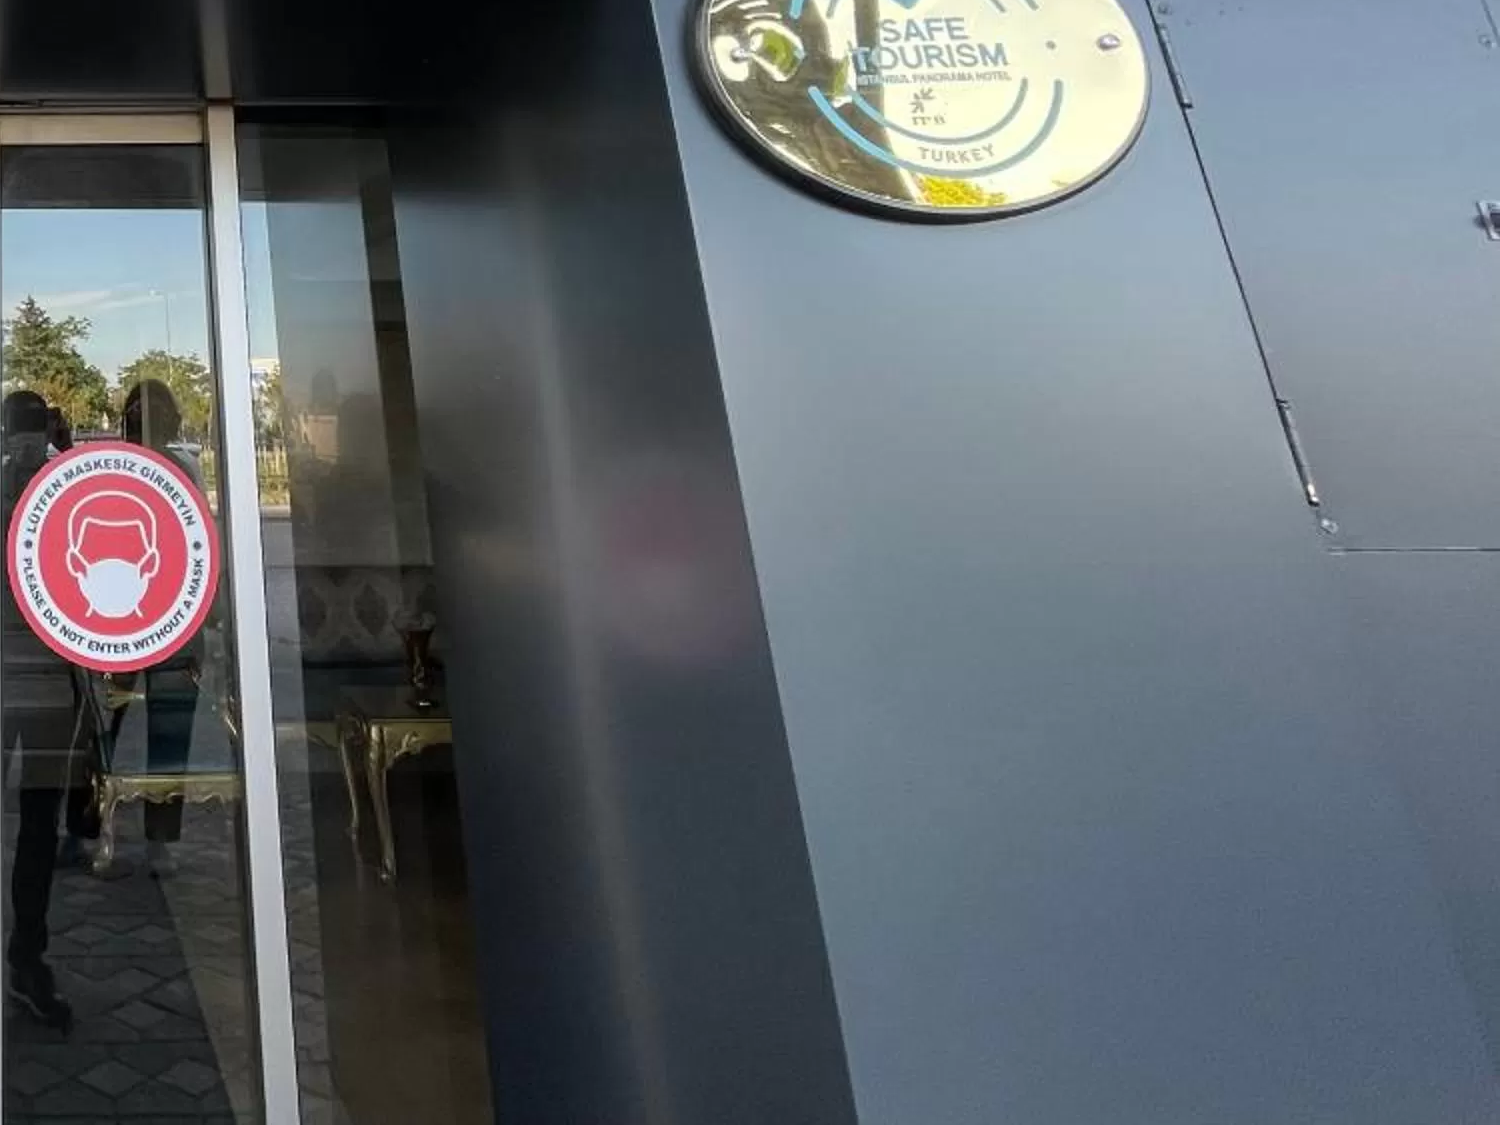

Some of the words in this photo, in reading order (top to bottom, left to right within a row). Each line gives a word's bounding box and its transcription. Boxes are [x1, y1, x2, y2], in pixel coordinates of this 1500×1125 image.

[880, 16, 969, 43] SAFE
[853, 42, 1010, 73] TOURISM
[917, 143, 996, 164] TURKEY
[22, 557, 46, 609] PLEASE
[186, 558, 204, 598] MASK
[43, 607, 60, 627] DO
[183, 600, 195, 612] A
[59, 621, 85, 646] NOT
[132, 611, 187, 651] WITHOUT
[87, 640, 131, 654] ENTER
